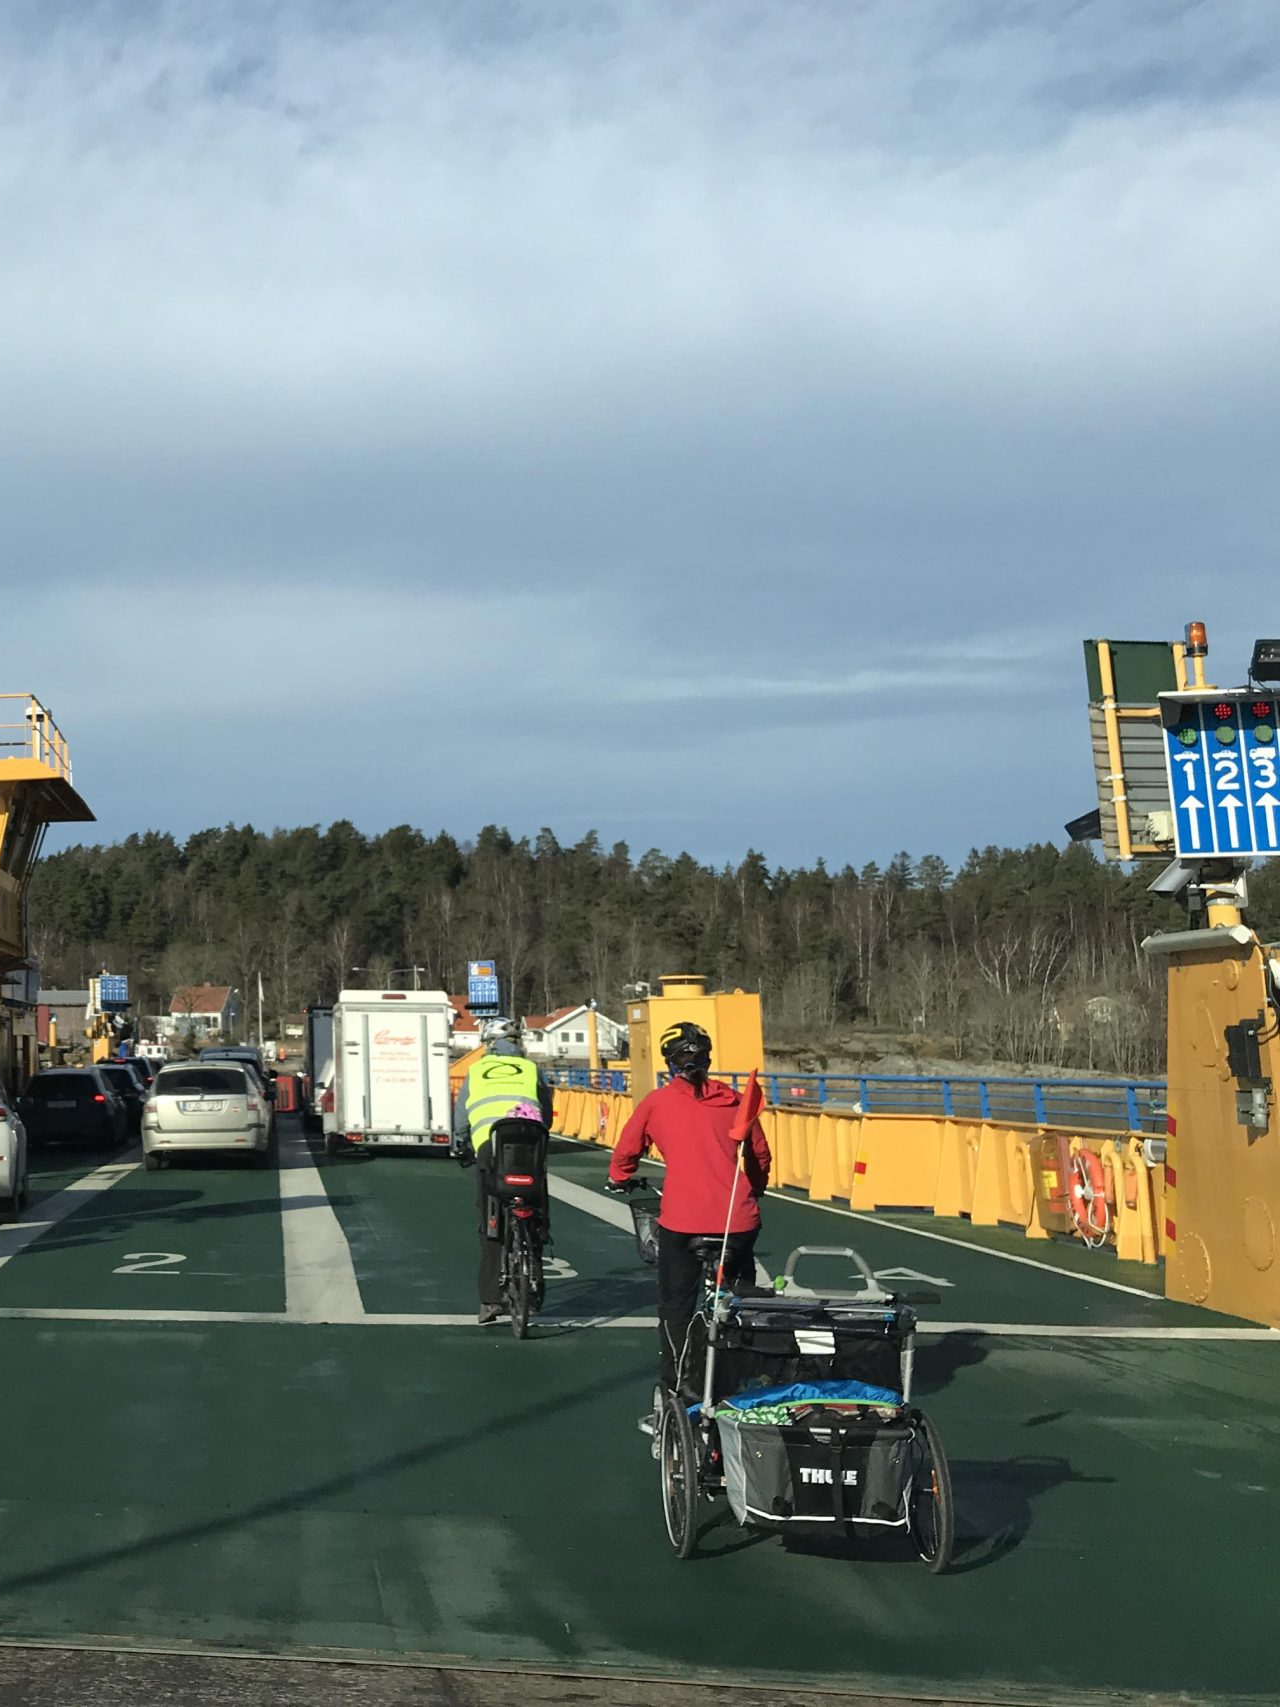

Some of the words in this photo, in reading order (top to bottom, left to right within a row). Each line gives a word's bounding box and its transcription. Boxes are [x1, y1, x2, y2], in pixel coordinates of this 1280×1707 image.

[1183, 761, 1196, 791] 1
[1214, 760, 1240, 790] 2
[1254, 759, 1276, 789] 3
[112, 1252, 187, 1274] 2
